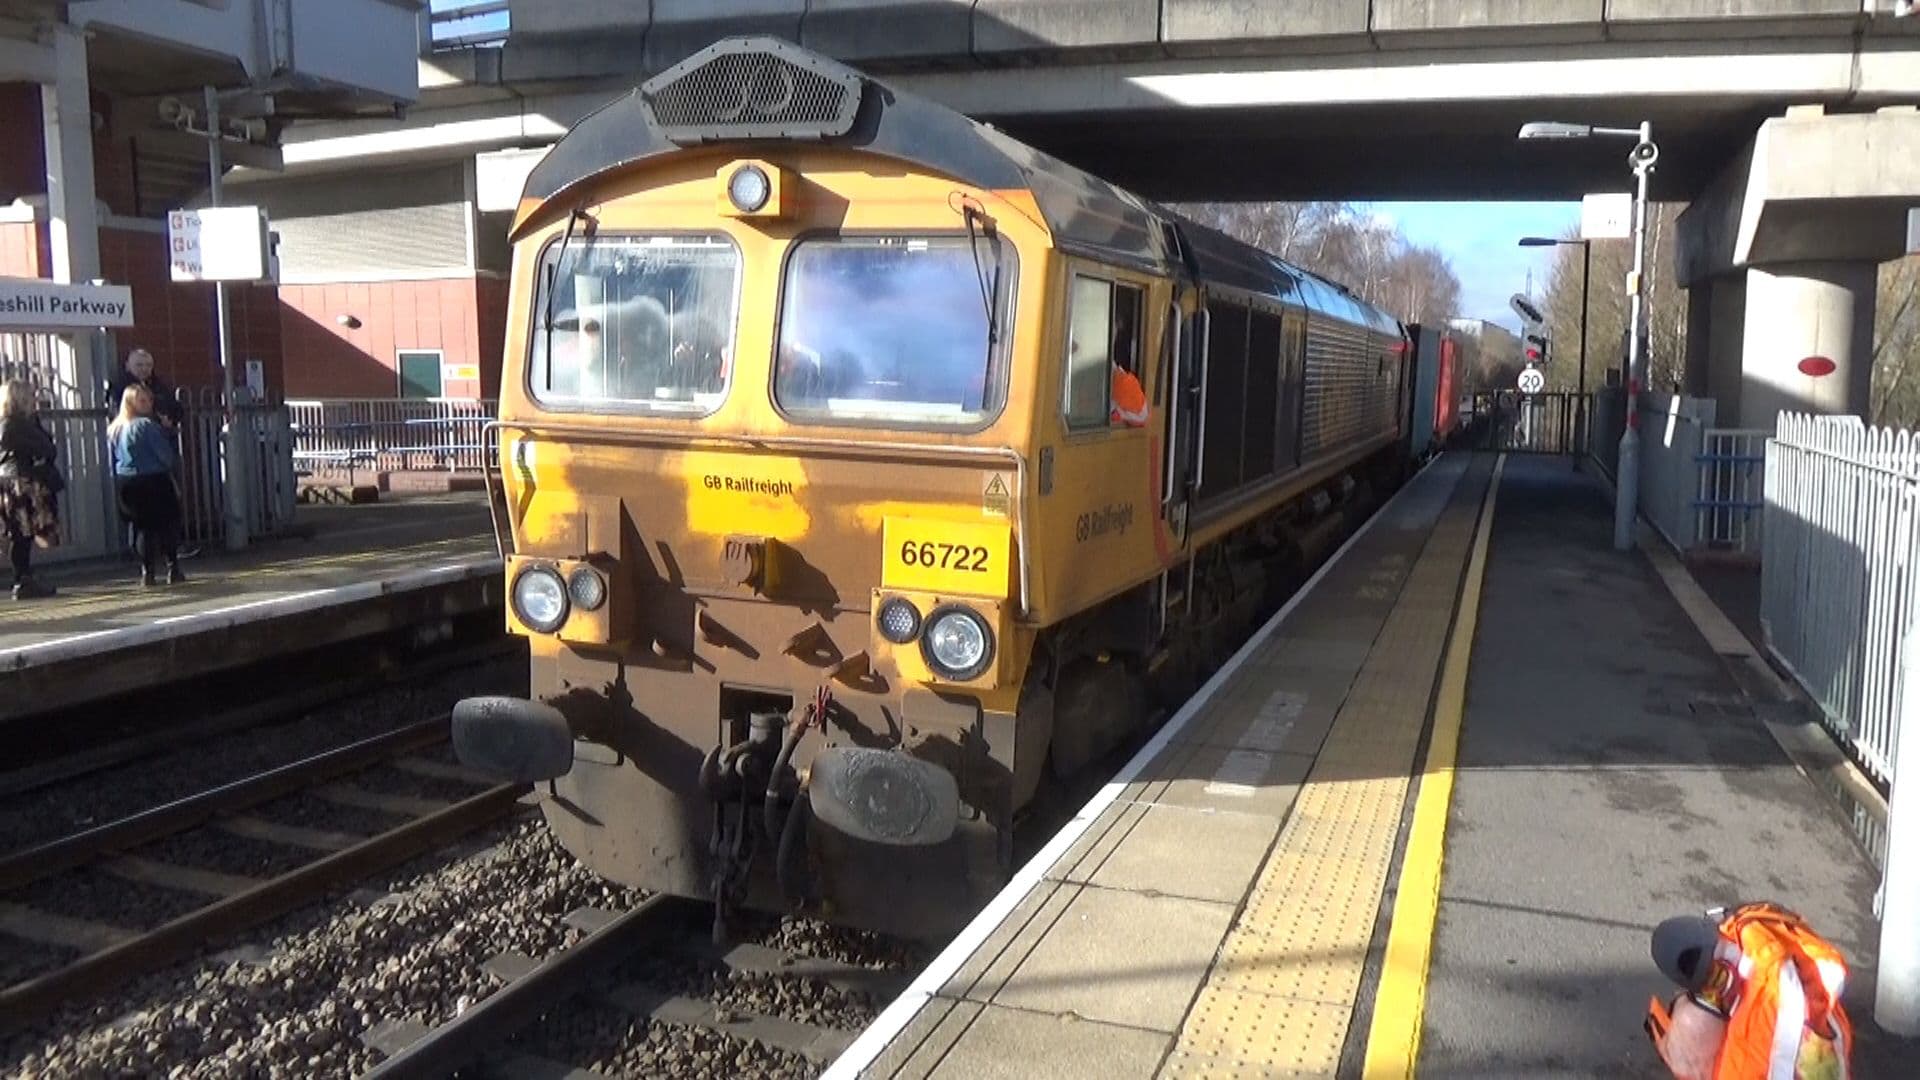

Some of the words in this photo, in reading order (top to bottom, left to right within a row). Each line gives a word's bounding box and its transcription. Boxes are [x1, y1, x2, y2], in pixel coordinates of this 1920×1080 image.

[50, 297, 126, 318] Parkway
[1522, 375, 1540, 388] 20
[703, 475, 722, 490] GB
[725, 477, 793, 497] Railfreight
[901, 540, 989, 572] 66722
